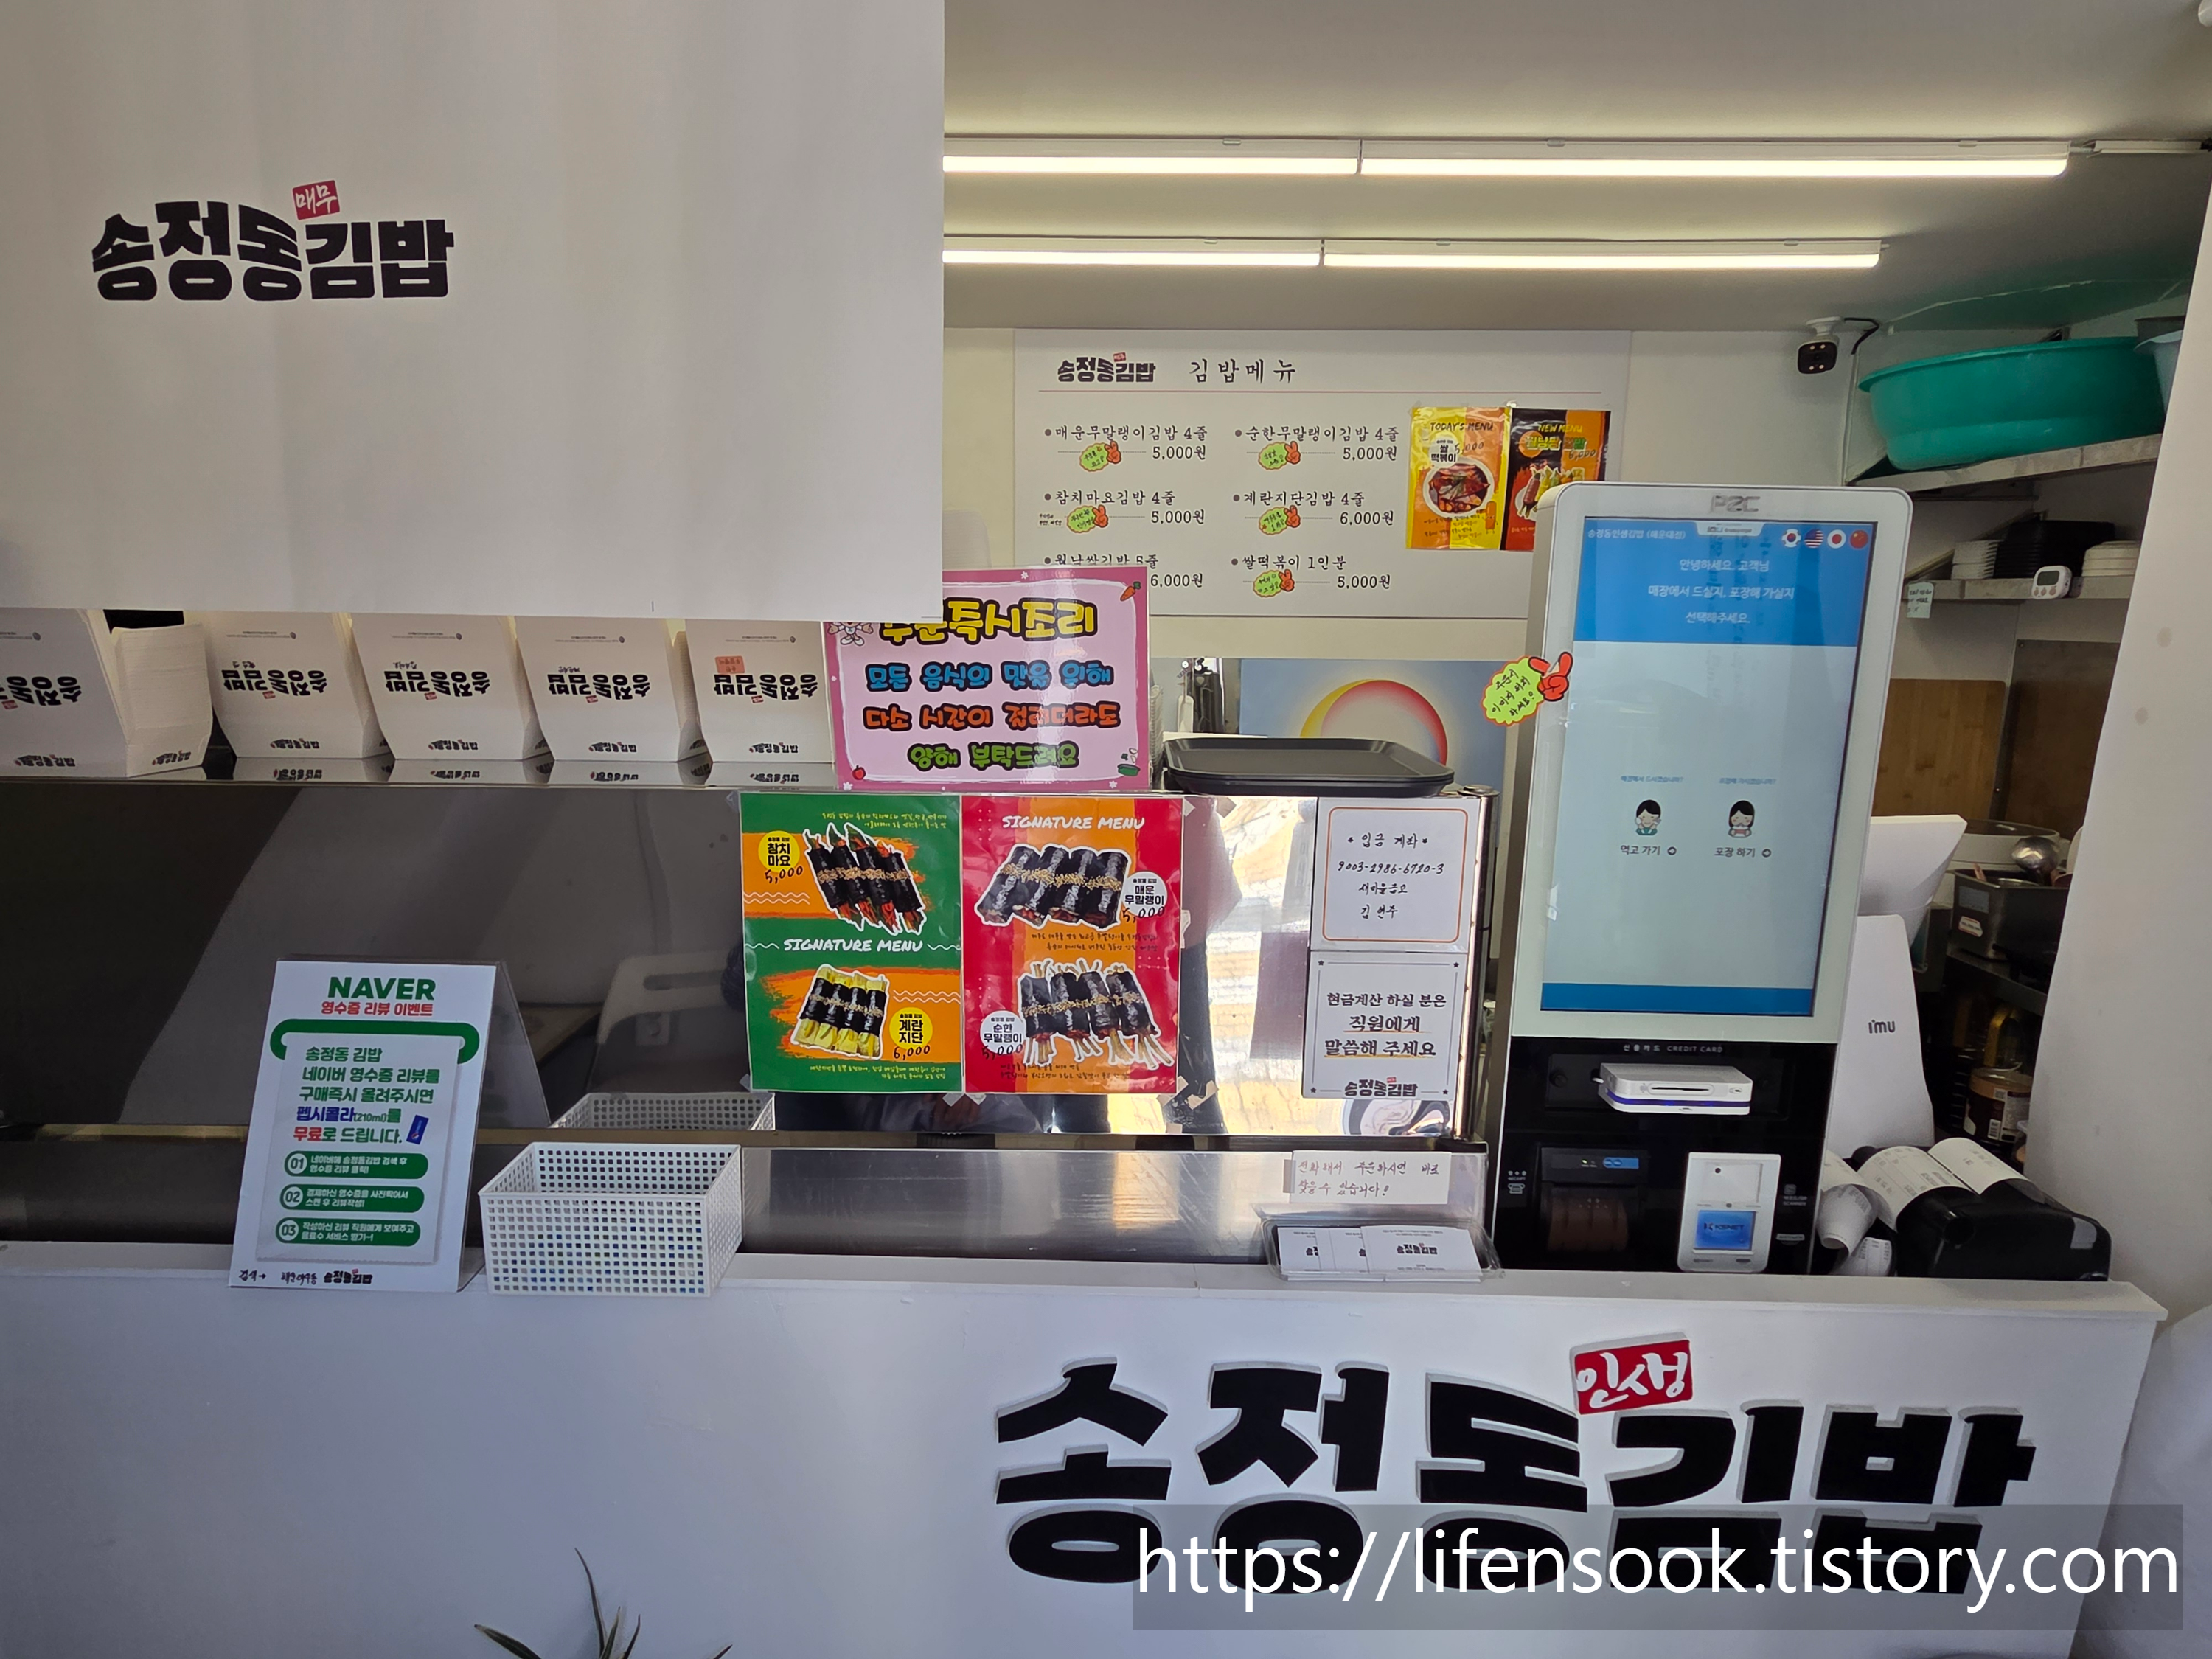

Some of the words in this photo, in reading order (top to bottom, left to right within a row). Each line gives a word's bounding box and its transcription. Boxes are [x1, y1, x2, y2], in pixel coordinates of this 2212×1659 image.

[92, 201, 454, 301] 송정동김밥
[1058, 357, 1156, 382] 송정동김밥
[1054, 426, 1177, 442] 매운무말랭이김밥
[1183, 426, 1208, 441] 4줄
[1245, 426, 1369, 442] 순한무말랭이김밥
[1375, 426, 1399, 442] 4줄
[1430, 422, 1465, 431] TODAY'S
[1468, 422, 1494, 431] MENU
[1538, 424, 1557, 432] NEW
[1558, 425, 1583, 433] MENU
[1152, 445, 1206, 461] 5,000원
[1343, 445, 1397, 462] 5,000원
[1568, 450, 1596, 461] 6,000
[1055, 490, 1145, 505] 참치마요김밥
[1151, 490, 1175, 505] 4줄
[1243, 490, 1335, 506] 계란지단김밥
[1340, 490, 1364, 505] 4줄
[1151, 510, 1205, 525] 5,000원
[1340, 511, 1394, 526] 6,000원
[1242, 554, 1299, 570] 쌀떡볶이
[1308, 555, 1346, 570] 1인분
[1738, 560, 1770, 572] 고객님
[1150, 574, 1203, 588] 6,000원
[1337, 574, 1391, 590] 5,000원
[1648, 585, 1690, 597] 매장에서
[1729, 587, 1761, 598] 포장해
[1762, 587, 1795, 599] 가실지
[866, 663, 912, 691] 모든
[920, 661, 992, 690] 음식의
[1001, 660, 1051, 690] 맛을
[1060, 659, 1113, 688] 위해
[221, 669, 327, 697] 송정동김밥
[384, 669, 490, 697] 송정동김밥
[547, 674, 650, 700] 송정동김밥
[714, 674, 818, 701] 송정동김밥
[0, 676, 82, 706] 송정동
[863, 703, 912, 731] 다소
[919, 703, 993, 730] 시간이
[908, 742, 960, 771] 양해
[969, 740, 1079, 771] 부탁드려요
[1002, 815, 1093, 830] SIGNATURE
[1097, 816, 1145, 830] MENU
[1362, 832, 1385, 847] 입금
[1394, 833, 1419, 849] 계좌
[768, 843, 790, 855] 참치
[1621, 844, 1638, 855] 먹고
[1641, 846, 1660, 855] 가기
[1714, 847, 1733, 857] 포장
[1736, 847, 1755, 858] 하기
[768, 855, 790, 866] 마요
[1338, 860, 1444, 874] 9003-2986-6720-3
[765, 866, 804, 884] 5,000
[1135, 886, 1154, 894] 매운
[1125, 895, 1164, 905] 무말랭이
[1121, 906, 1165, 923] 5,000
[784, 938, 872, 952] SIGNATURE
[877, 939, 923, 952] MENU
[328, 977, 436, 1000] NAVER
[1327, 992, 1382, 1006] 현금계산
[1387, 993, 1414, 1006] 하실
[1418, 994, 1447, 1008] 분은
[321, 1001, 361, 1015] 영수증
[364, 1002, 390, 1015] 리뷰
[394, 1003, 433, 1016] 이벤트
[899, 1019, 923, 1032] 계란
[993, 1023, 1012, 1033] 순한
[1349, 1015, 1420, 1032] 직원에게
[899, 1032, 923, 1043] 지단
[984, 1033, 1022, 1043] 무말랭이
[306, 1047, 349, 1062] 송정동
[353, 1047, 383, 1062] 김밥
[894, 1045, 931, 1060] 6,000
[981, 1043, 1023, 1060] 5,000
[1324, 1039, 1377, 1056] 말씀해
[1382, 1040, 1436, 1056] 주세요
[302, 1066, 346, 1082] 네이버
[349, 1067, 393, 1083] 영수증
[397, 1068, 440, 1084] 리뷰를
[299, 1086, 358, 1102] 구매즉시
[361, 1088, 434, 1104] 올려주시면
[1345, 1079, 1418, 1096] 송정동김밥
[293, 1127, 337, 1142] 무료로
[340, 1128, 403, 1144] 드립니다.
[290, 1158, 304, 1169] 01
[382, 1156, 397, 1165] 검색
[399, 1156, 407, 1165] 후
[1422, 1163, 1439, 1175] 바로
[285, 1191, 301, 1203] 02
[322, 1198, 330, 1207] 후
[282, 1224, 296, 1236] 03
[302, 1222, 333, 1231] 작성하신
[334, 1223, 349, 1232] 리뷰
[383, 1225, 414, 1233] 보여주고
[1397, 1244, 1437, 1255] 송정동김밥
[324, 1270, 372, 1284] 송정동김밥
[1575, 1352, 1688, 1408] 인생
[995, 1355, 2037, 1596] 송정동김밥
